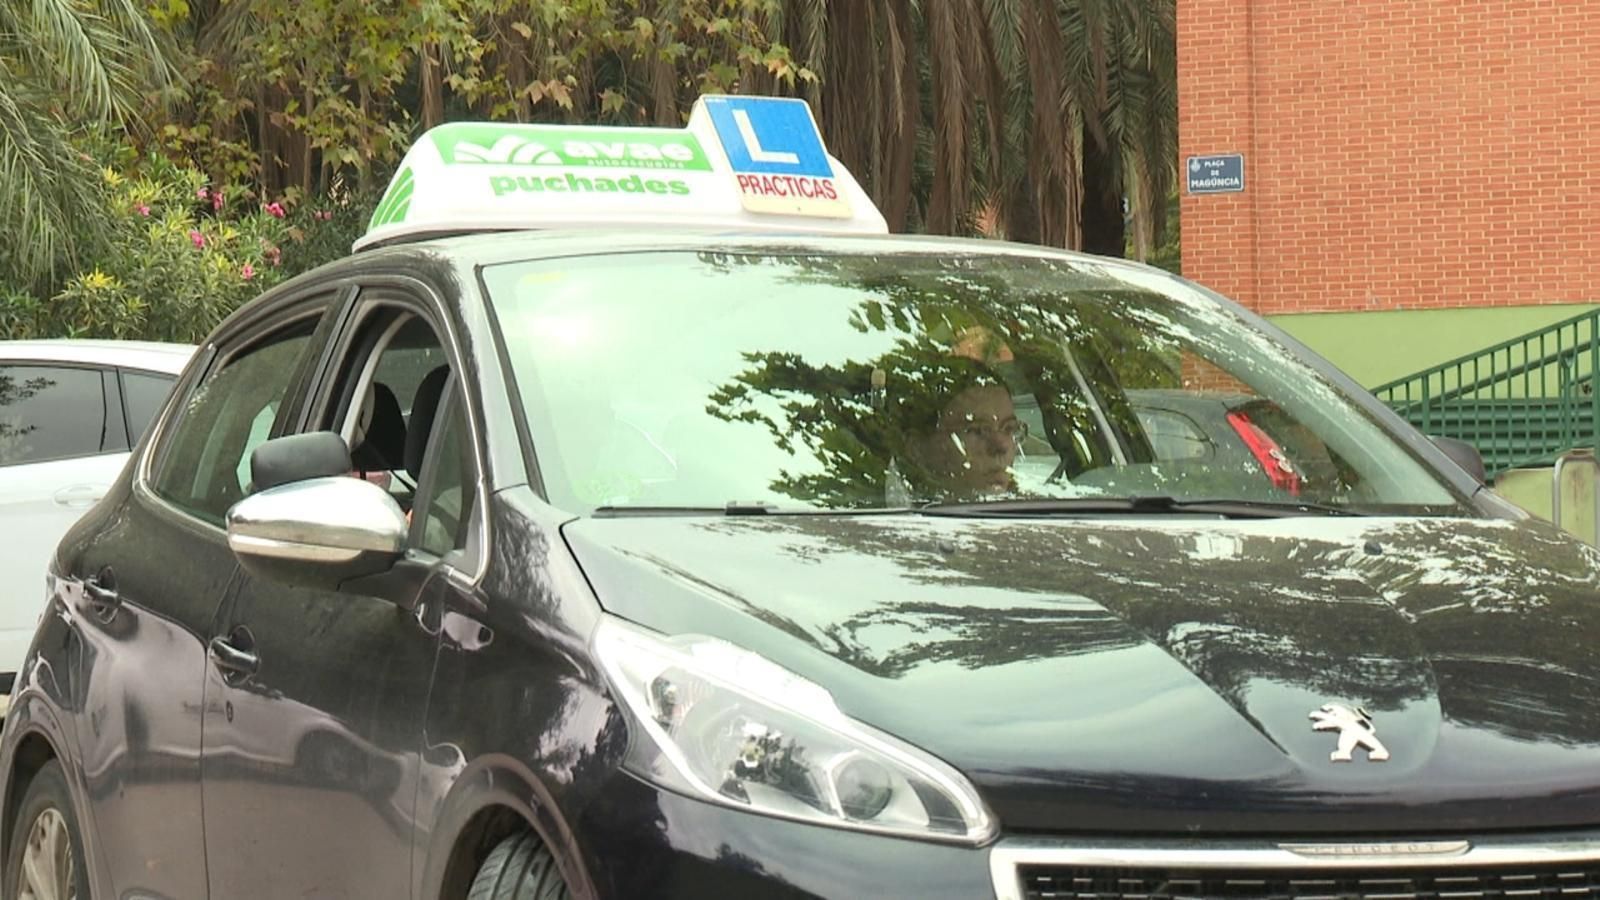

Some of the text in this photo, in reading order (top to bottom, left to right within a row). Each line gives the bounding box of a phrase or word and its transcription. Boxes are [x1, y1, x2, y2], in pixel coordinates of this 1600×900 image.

[732, 109, 801, 164] L
[563, 140, 694, 161] avae
[1204, 160, 1225, 168] PLAÇA
[489, 173, 690, 196] puchades
[737, 174, 838, 200] PRACTICAS
